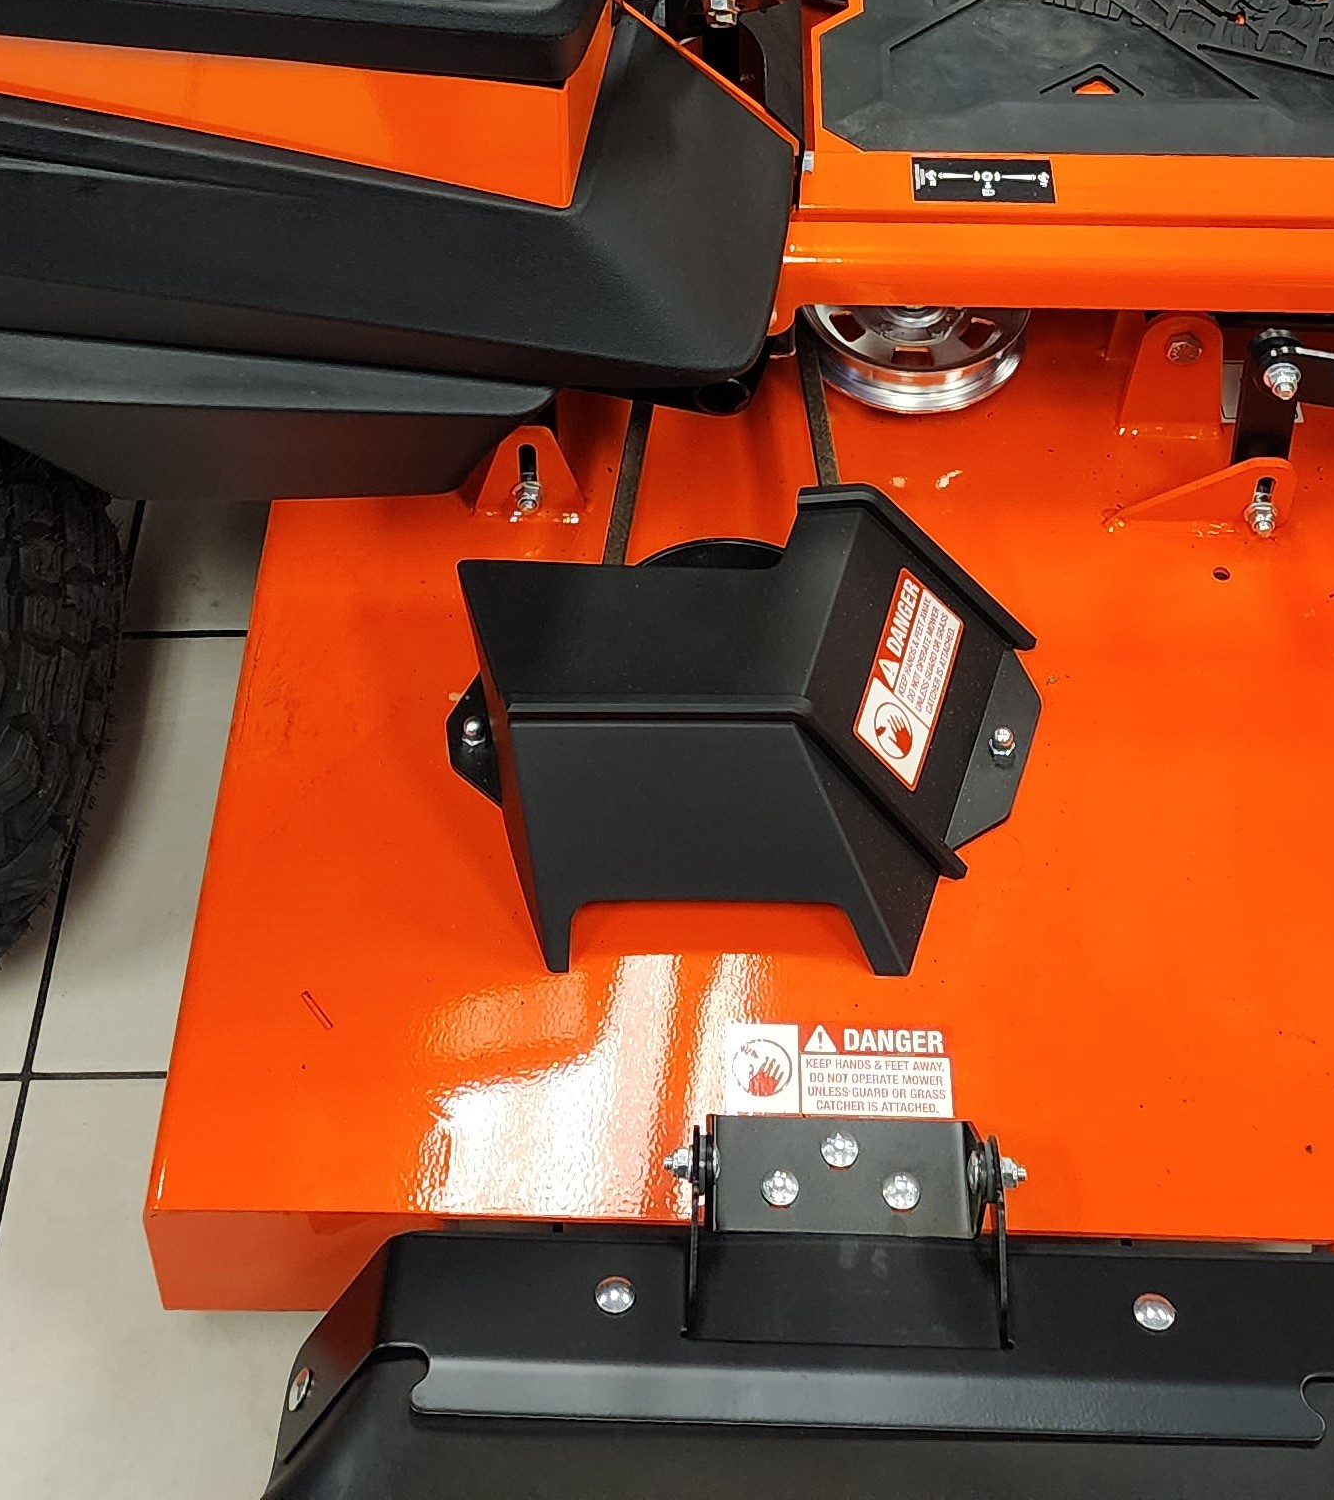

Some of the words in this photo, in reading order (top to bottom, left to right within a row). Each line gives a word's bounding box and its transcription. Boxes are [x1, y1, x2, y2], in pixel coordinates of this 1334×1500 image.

[886, 578, 920, 658] DANGER
[898, 673, 907, 697] KEEP
[914, 619, 924, 640] FEET
[916, 635, 930, 671] OPERATE
[910, 671, 920, 689] NOT
[906, 688, 915, 703] DO
[915, 679, 929, 712] UNLESS
[925, 677, 940, 714] CATCHER
[843, 1028, 945, 1054] DANGER
[805, 1057, 832, 1069] KEEP
[835, 1059, 871, 1070] HANDS
[874, 1060, 883, 1070] &
[884, 1060, 909, 1071] FEET
[809, 1072, 825, 1083] DO
[828, 1073, 848, 1084] NOT
[851, 1073, 899, 1085] OPERATE
[902, 1075, 943, 1086] MOWER
[808, 1085, 848, 1097] UNLESS
[851, 1087, 889, 1098] GUARD
[892, 1088, 907, 1099] OR
[910, 1088, 947, 1100] GRASS
[816, 1099, 865, 1111] CATCHER
[868, 1101, 878, 1112] IS
